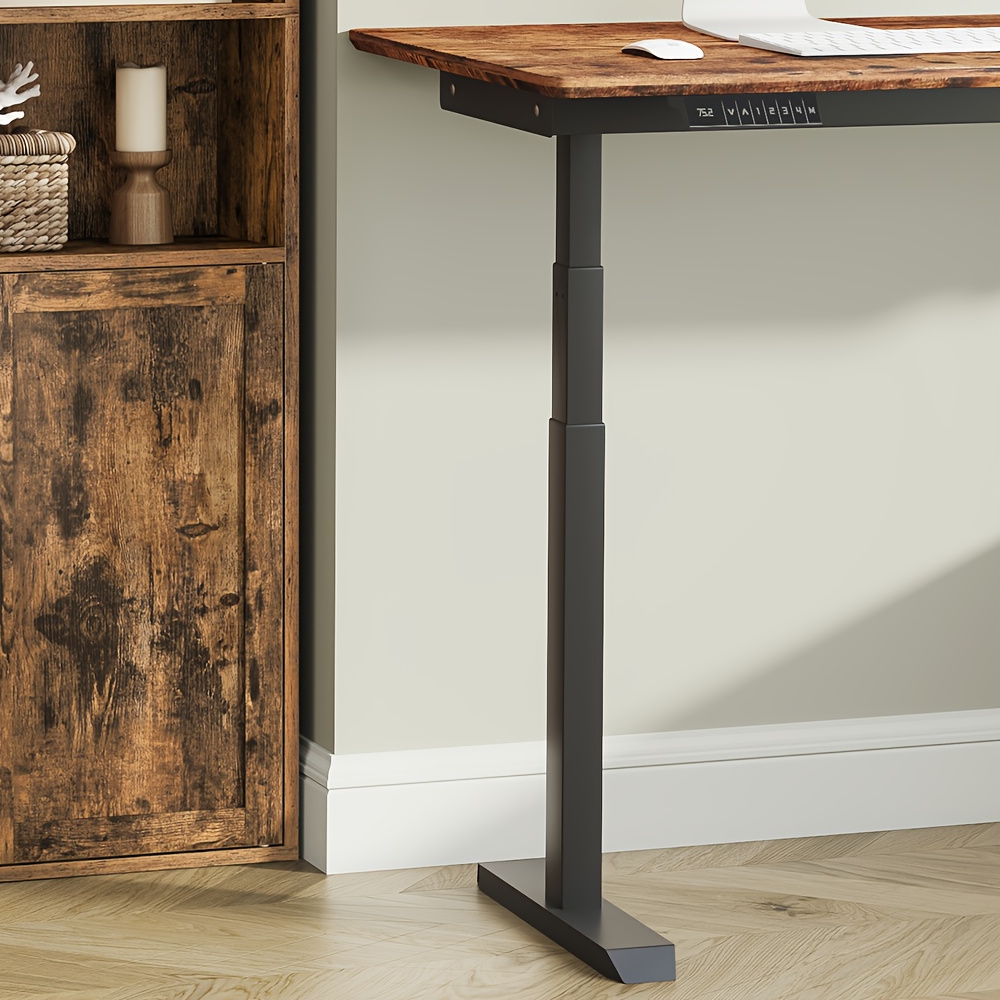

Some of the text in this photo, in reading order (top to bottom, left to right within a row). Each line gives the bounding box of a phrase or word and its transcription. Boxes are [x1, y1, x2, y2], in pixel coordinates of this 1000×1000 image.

[756, 107, 761, 115] 1
[768, 106, 776, 115] 2
[781, 106, 789, 115] 3
[795, 106, 803, 114] 4
[807, 106, 817, 114] M
